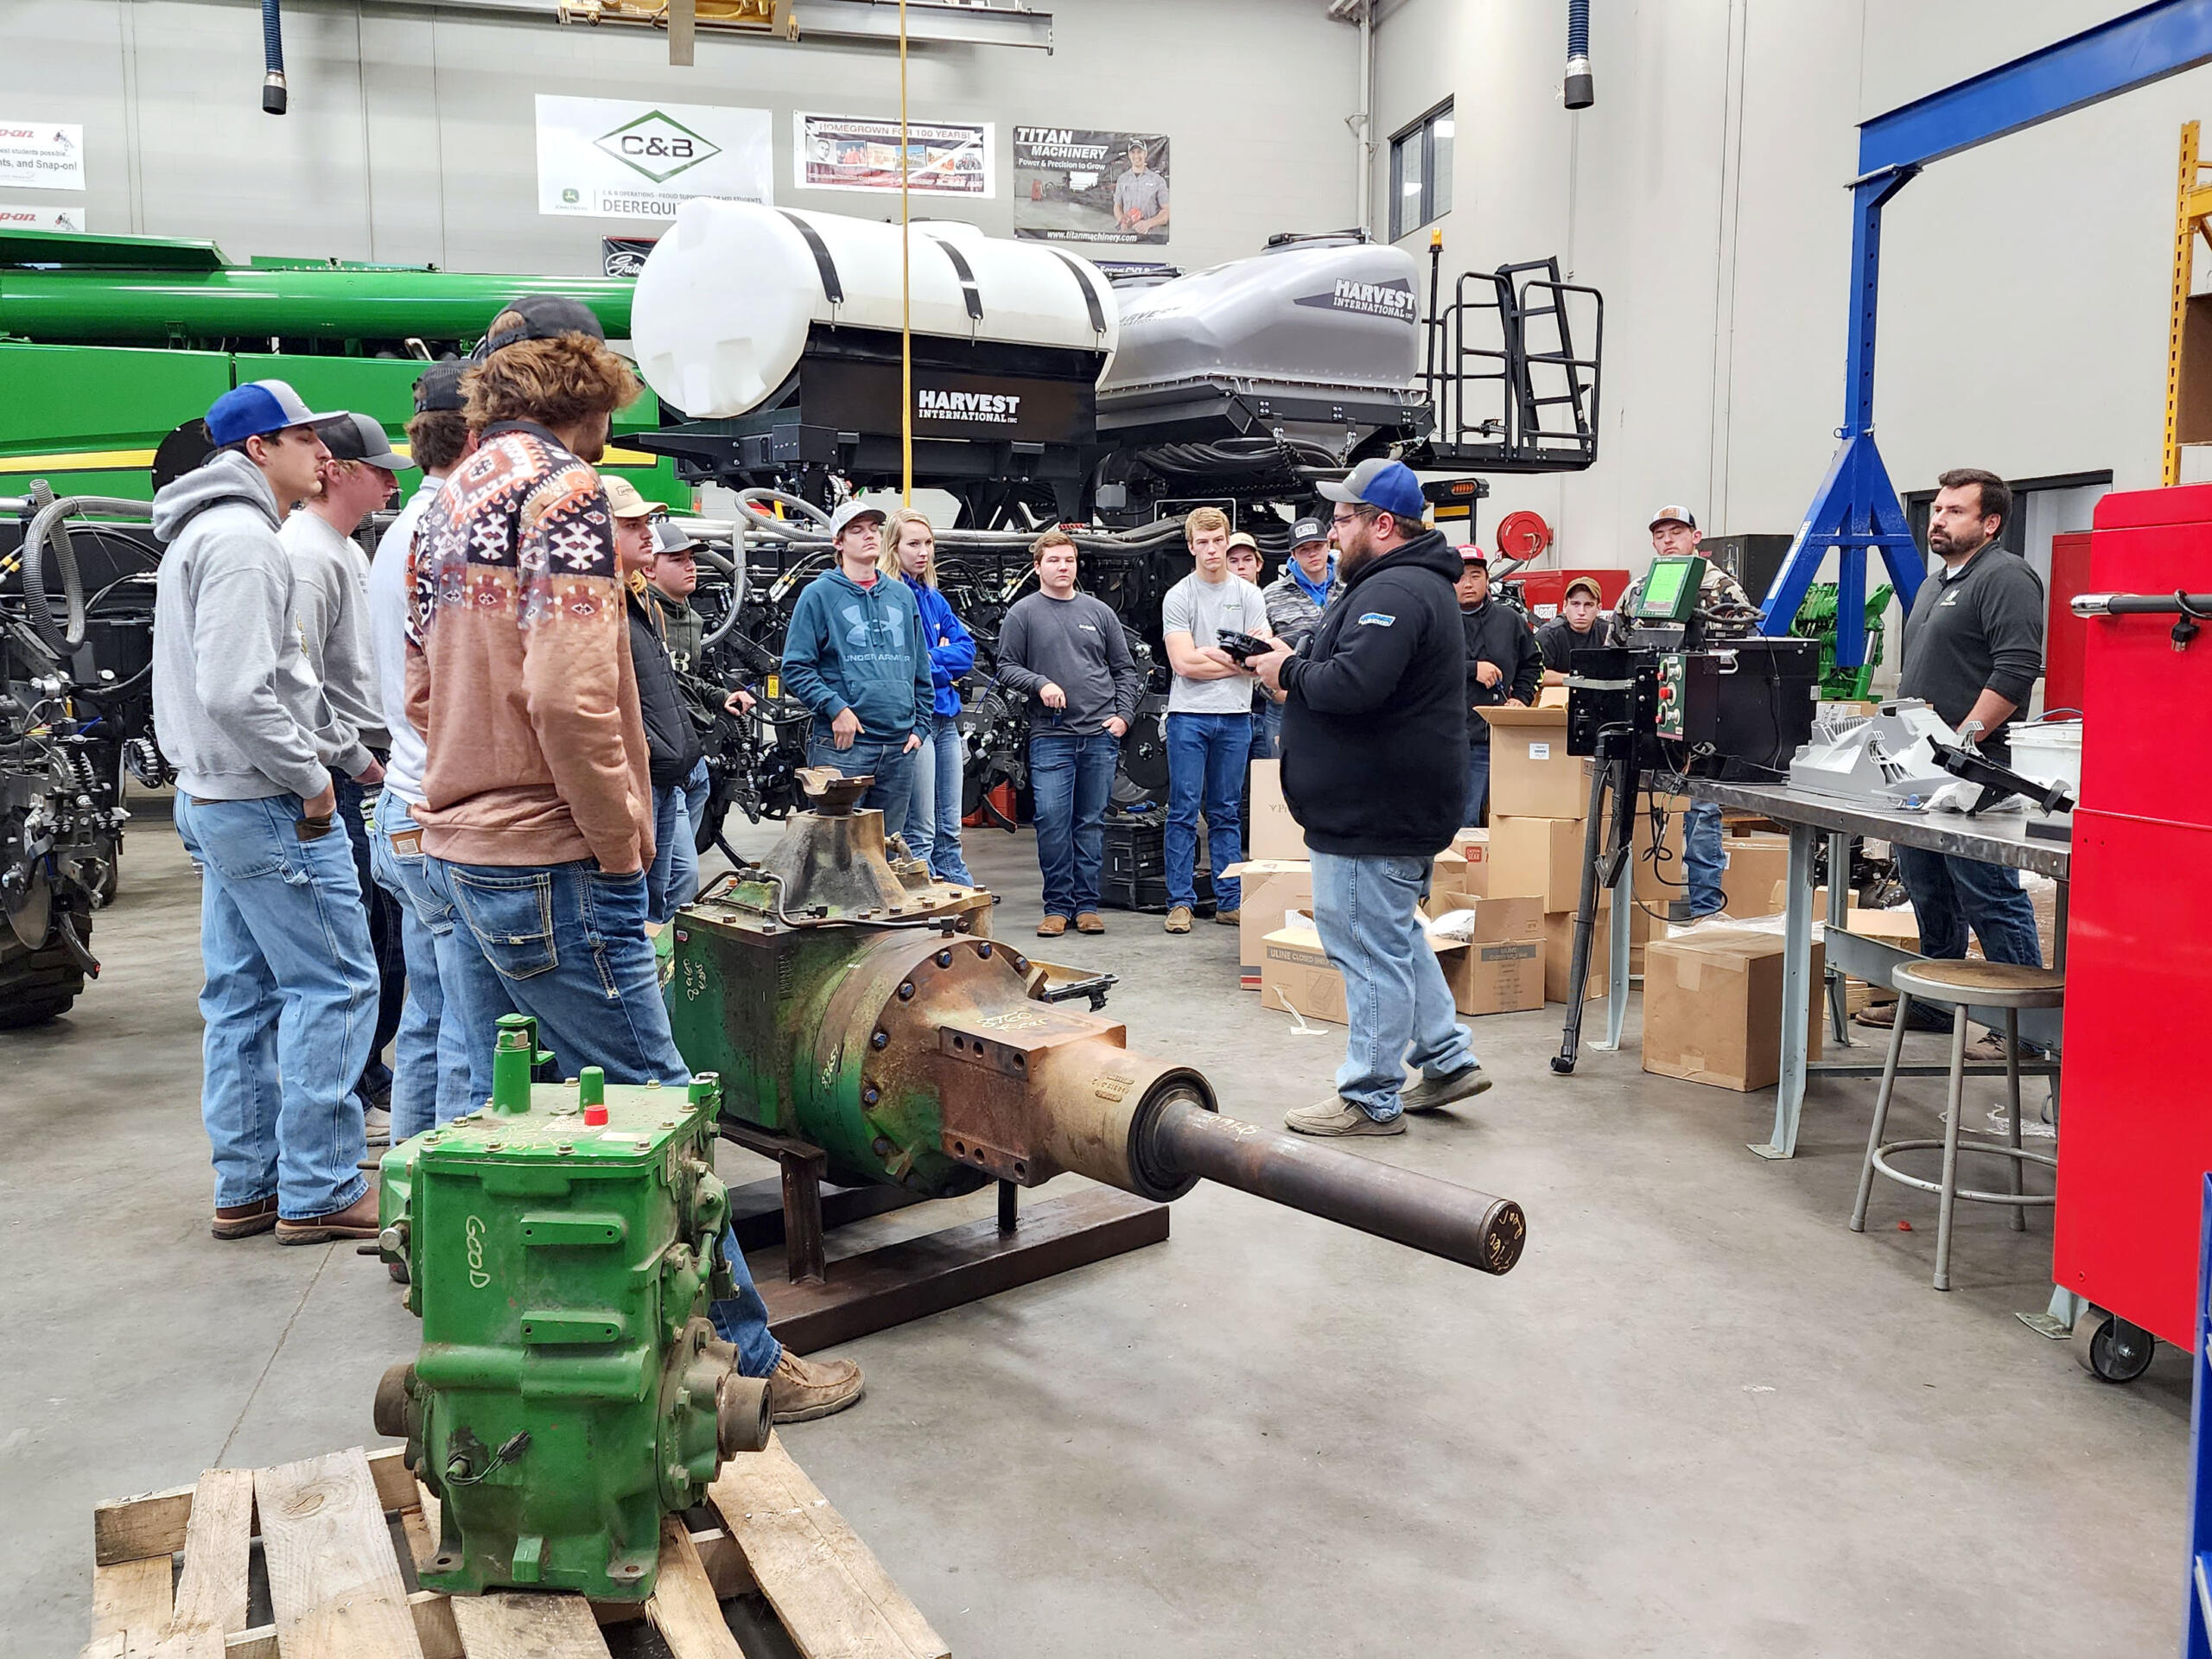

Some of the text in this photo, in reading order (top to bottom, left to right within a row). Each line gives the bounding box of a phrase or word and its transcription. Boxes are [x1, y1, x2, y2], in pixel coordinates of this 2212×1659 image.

[820, 124, 889, 135] HOMEGROWN
[936, 130, 970, 139] YEARS!
[1017, 128, 1072, 144] TITAN
[621, 136, 694, 157] C&B
[1031, 145, 1107, 159] MACHINERY
[36, 160, 77, 171] Snap-on!
[1019, 158, 1040, 167] Power
[1047, 160, 1077, 168] Precision
[1087, 162, 1106, 171] Grow
[602, 199, 677, 215] DEEREQUI
[1046, 231, 1138, 243] www.titanmachinery.com
[607, 255, 644, 276] Gate
[1334, 279, 1415, 310] HARVEST
[1333, 296, 1405, 318] INTERNATIONAL
[918, 390, 1020, 414] HARVEST
[918, 409, 1007, 423] INTERNATIONAL
[844, 653, 911, 663] UNDER ARMR
[1270, 949, 1291, 960] ULINE
[1292, 952, 1313, 963] CLOSED
[465, 1214, 492, 1289] GOOD
